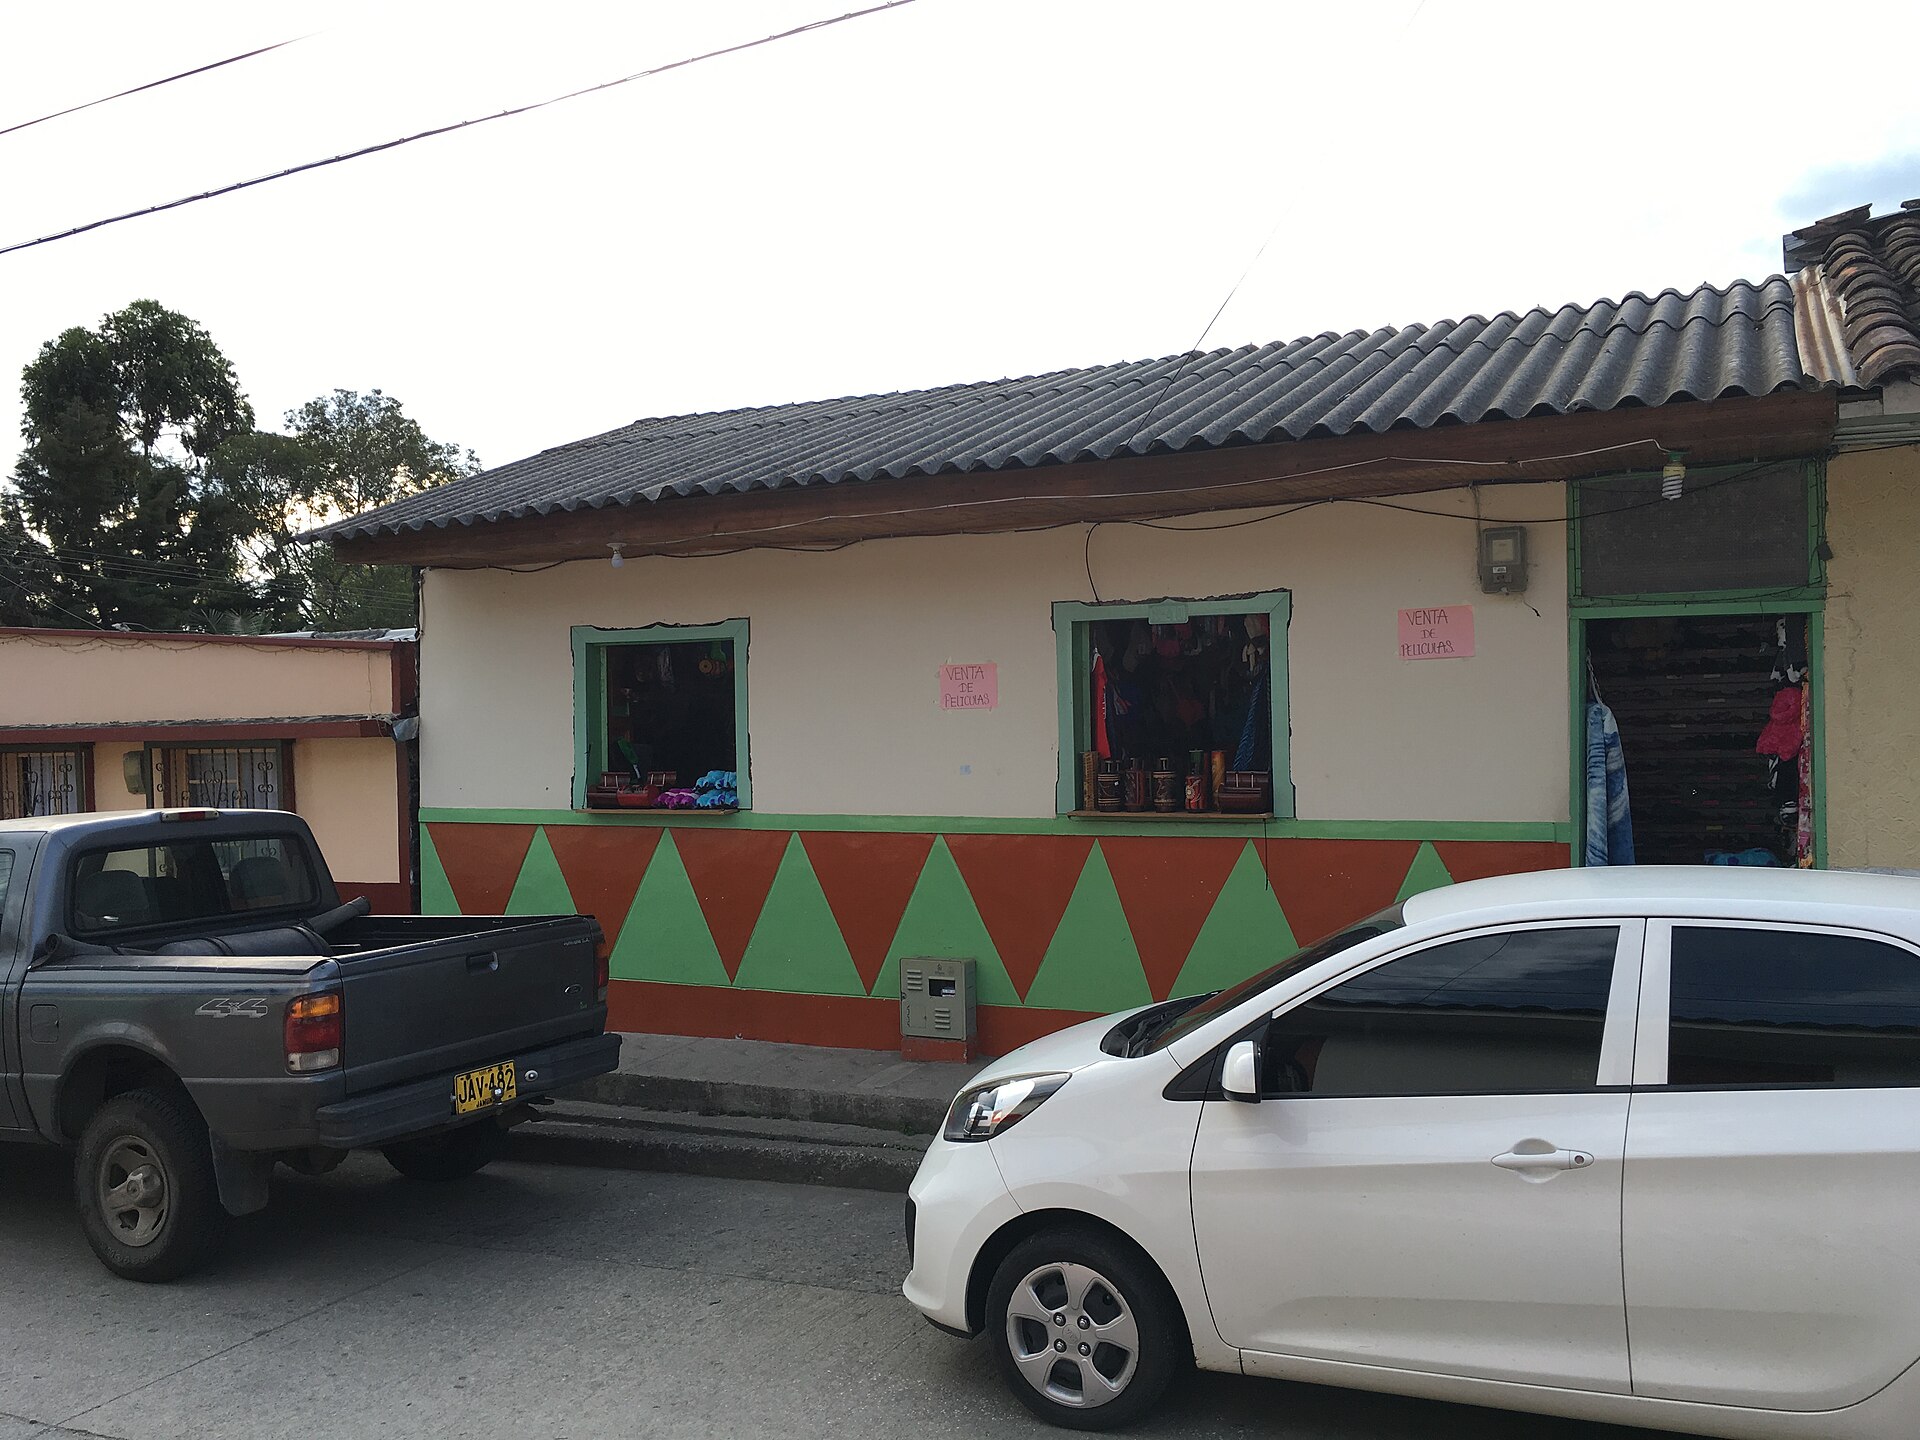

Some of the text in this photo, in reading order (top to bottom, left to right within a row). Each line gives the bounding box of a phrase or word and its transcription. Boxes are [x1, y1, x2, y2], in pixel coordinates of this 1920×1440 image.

[1405, 609, 1448, 625] VENTA
[1421, 628, 1438, 639] DE
[1401, 640, 1455, 656] PELICULAS
[945, 666, 984, 680] VENTA
[959, 682, 973, 692] DE
[944, 693, 990, 707] PELICULAS
